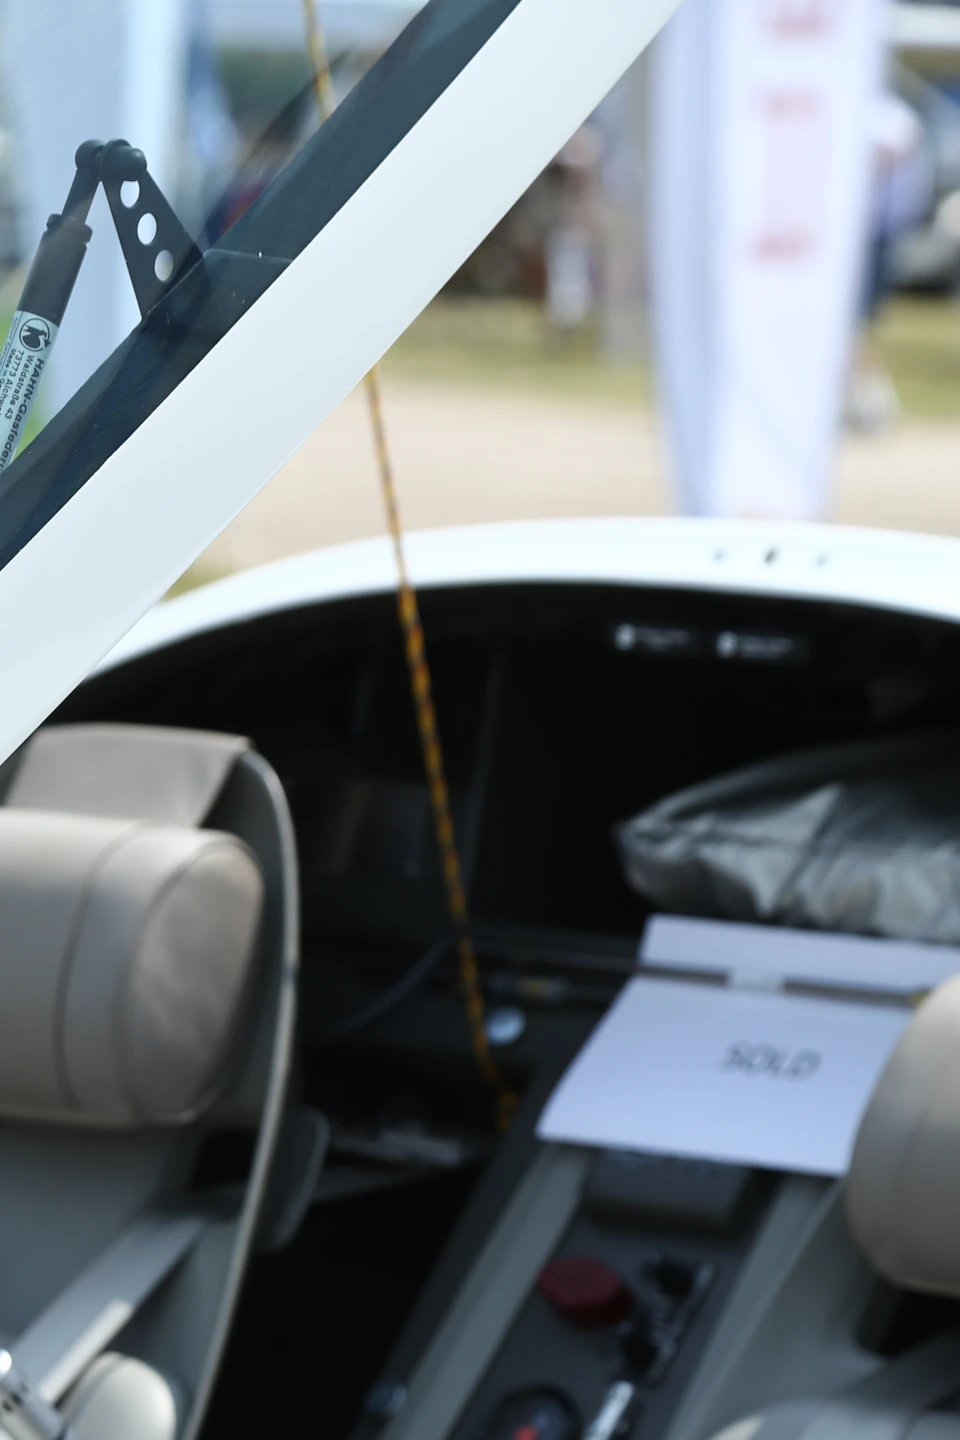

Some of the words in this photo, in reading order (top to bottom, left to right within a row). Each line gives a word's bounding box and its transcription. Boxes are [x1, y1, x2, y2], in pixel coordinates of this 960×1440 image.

[6, 348, 17, 368] Made
[9, 349, 24, 377] 73773
[9, 354, 35, 406] Waldstraße
[4, 407, 14, 420] 43
